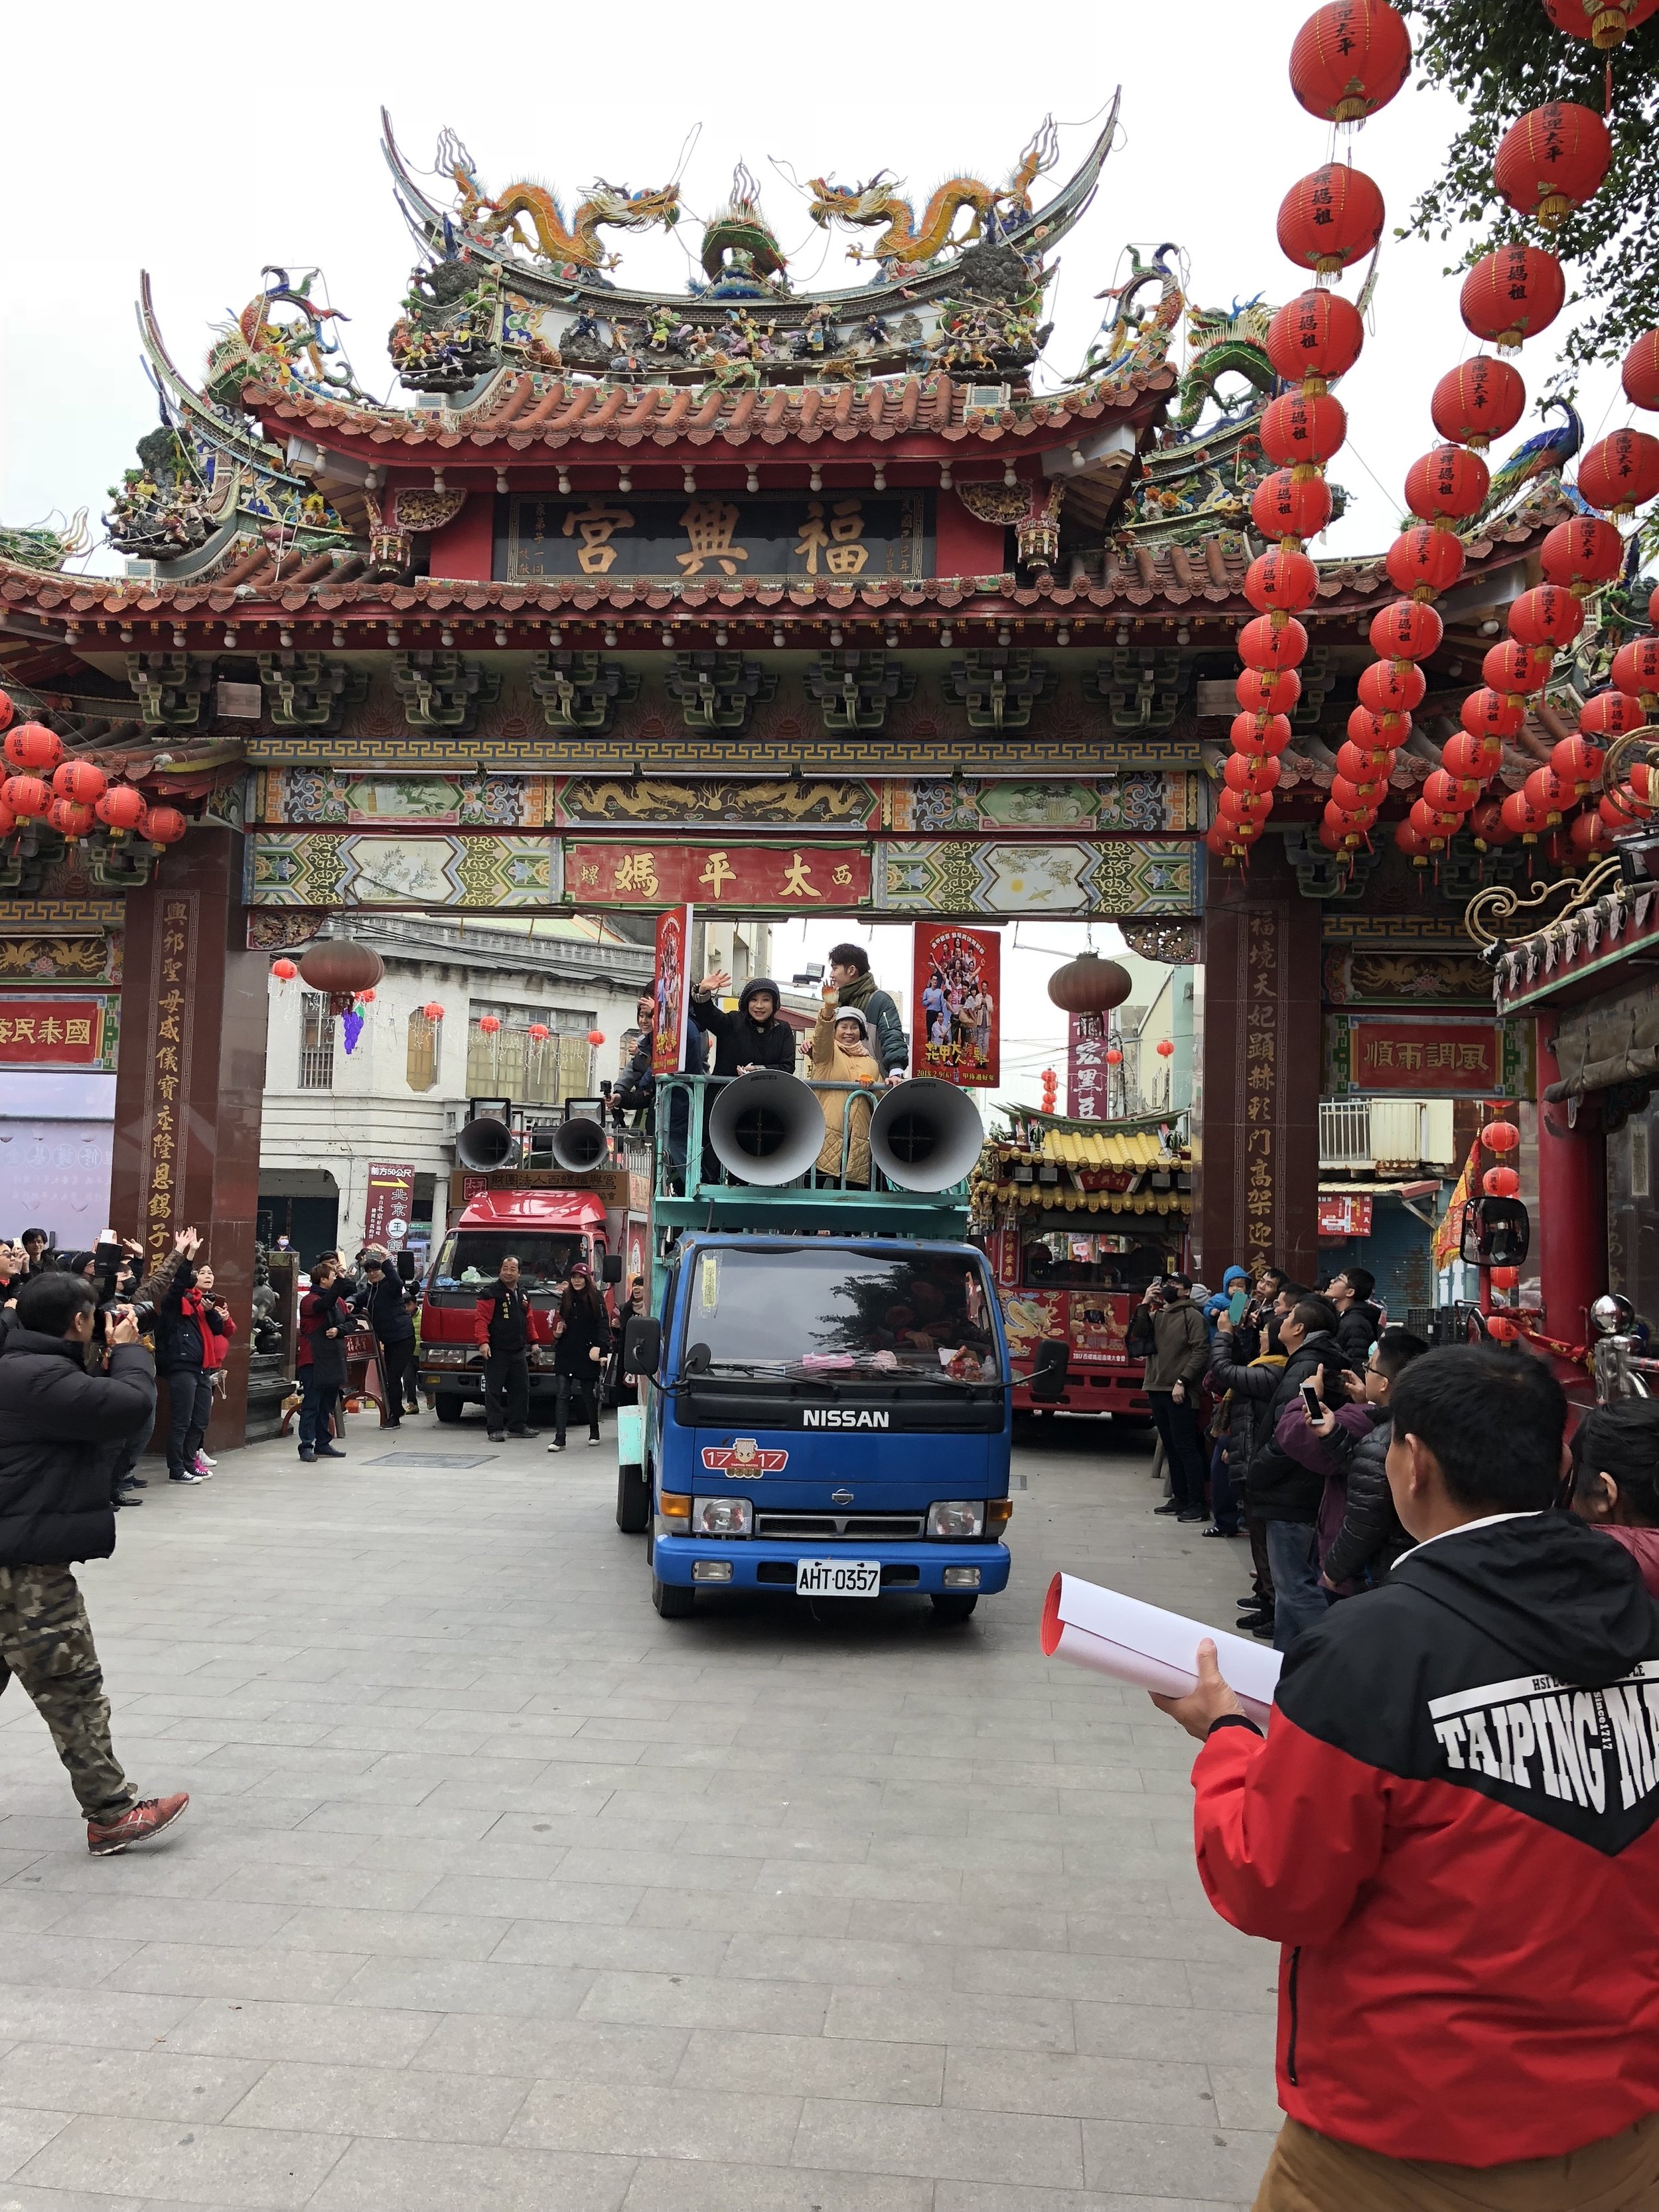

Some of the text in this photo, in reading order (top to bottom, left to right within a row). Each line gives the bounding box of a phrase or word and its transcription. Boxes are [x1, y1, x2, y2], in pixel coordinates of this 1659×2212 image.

[371, 1167, 412, 1177] 前方50公尺
[803, 1409, 889, 1428] NISSAN
[707, 1451, 783, 1467] 17 17
[1532, 1676, 1551, 1691] HSI
[1600, 1723, 1613, 1750] 1717
[1433, 1690, 1606, 1814] TAIPING
